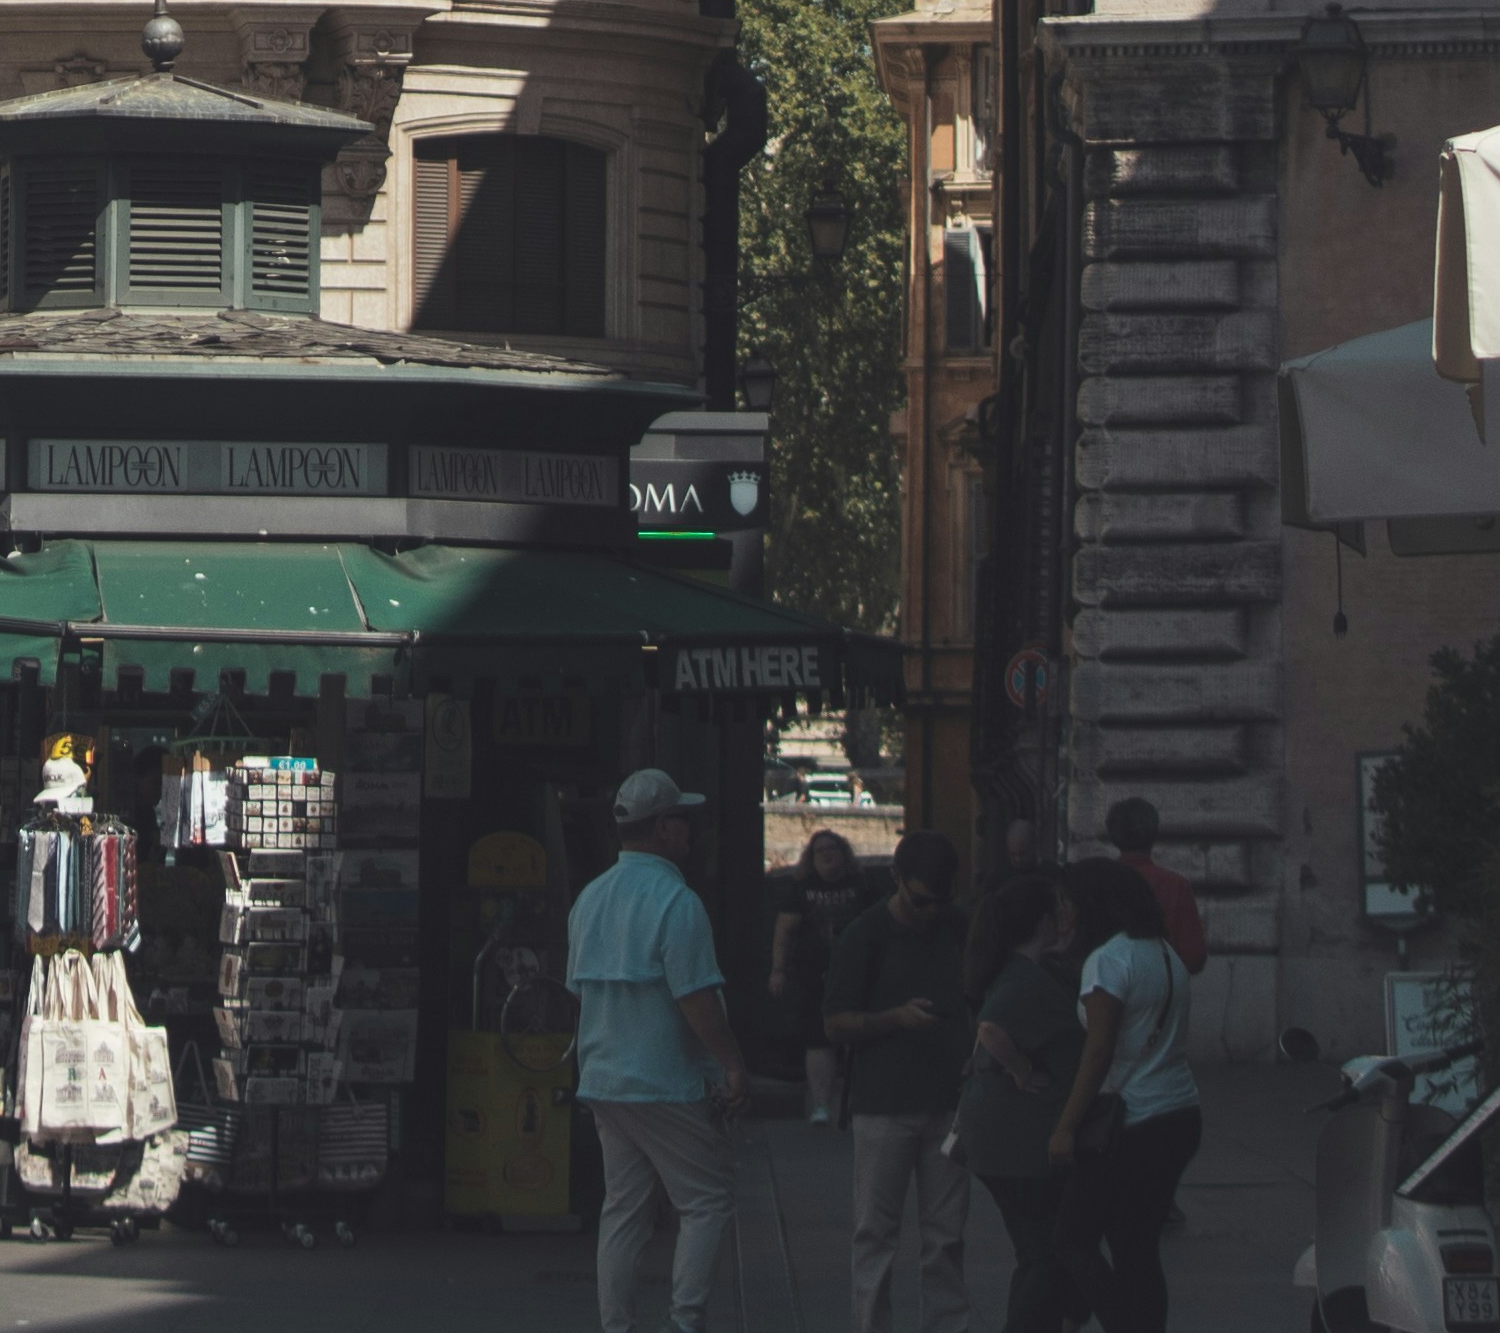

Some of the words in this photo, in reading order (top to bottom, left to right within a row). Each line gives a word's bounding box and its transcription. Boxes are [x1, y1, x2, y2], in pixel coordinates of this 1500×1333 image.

[47, 444, 182, 486] LAMPOON
[228, 447, 361, 489] LAMPOON
[417, 450, 498, 494] LAMPOON
[524, 456, 605, 501] LAMPOON
[675, 648, 738, 689] ATM
[742, 646, 821, 687] HERE
[499, 696, 573, 736] ATM
